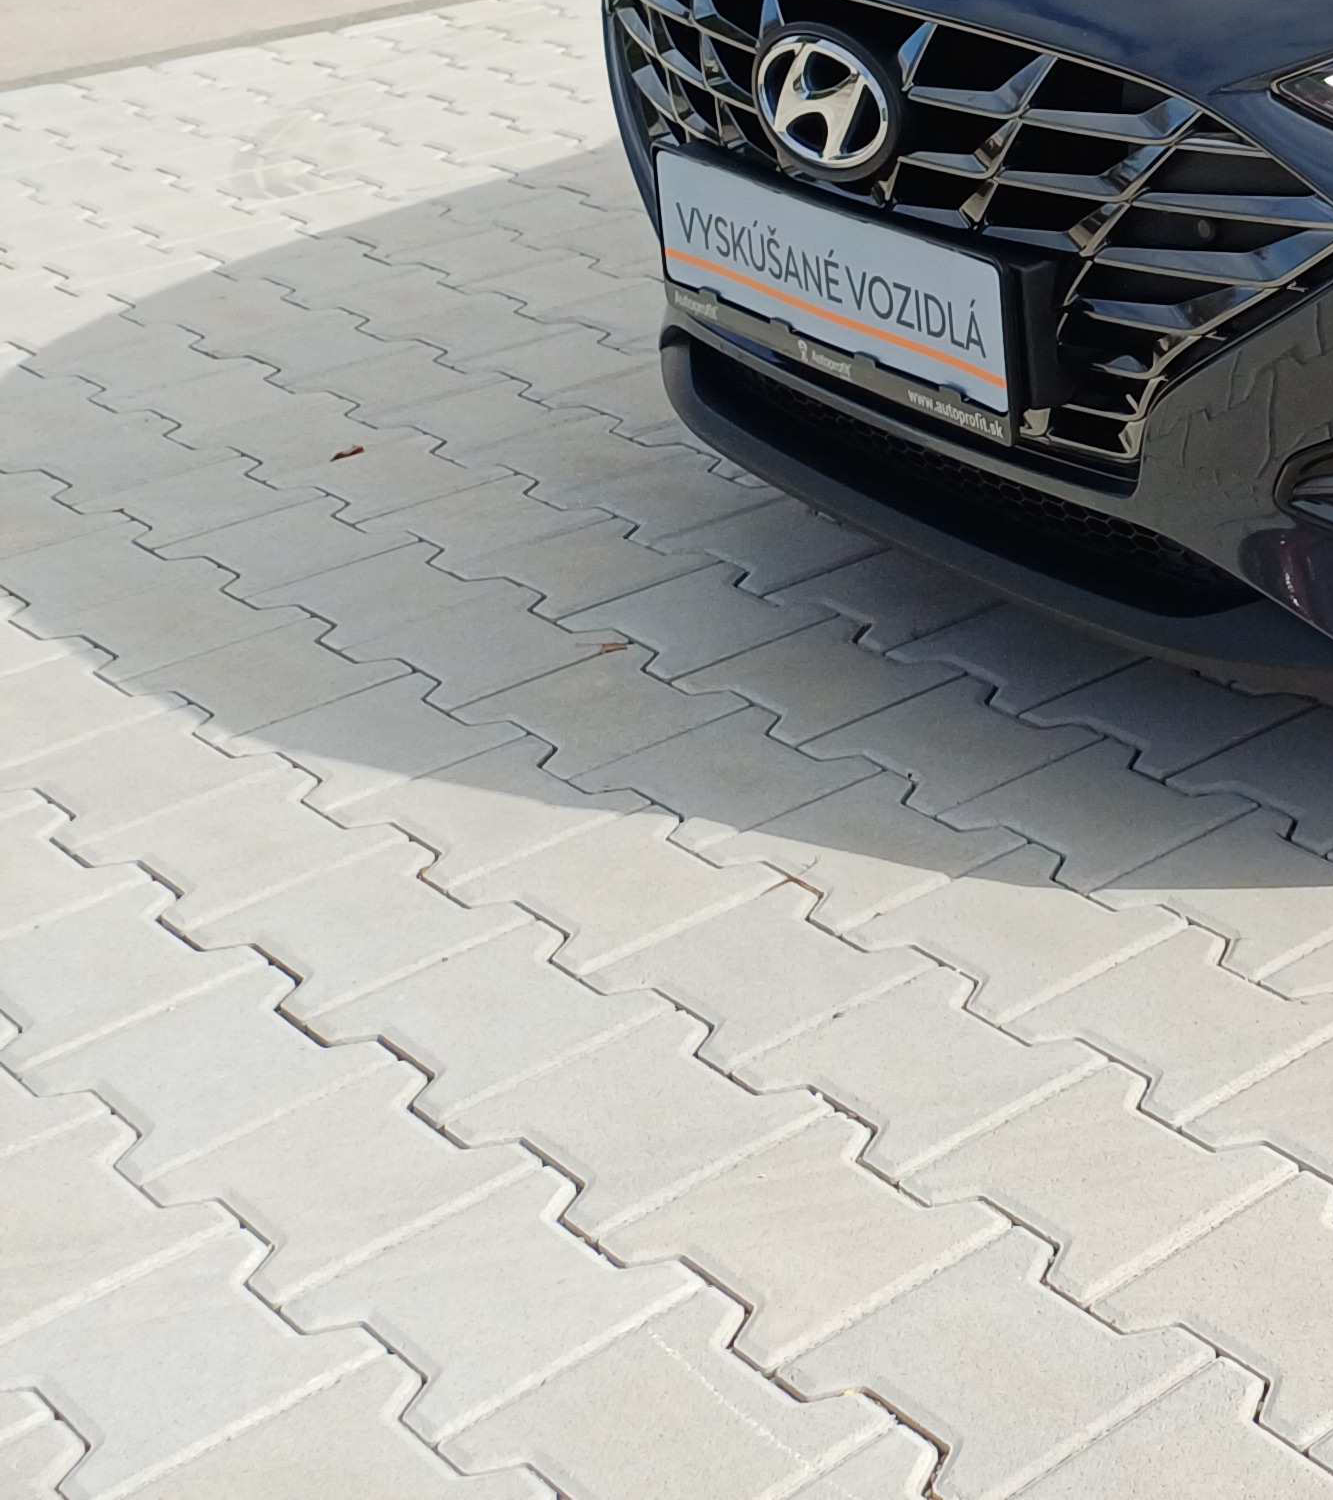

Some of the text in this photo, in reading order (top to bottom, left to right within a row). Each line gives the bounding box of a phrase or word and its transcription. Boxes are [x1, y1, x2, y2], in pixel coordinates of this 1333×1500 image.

[676, 201, 988, 359] VYSKÚŠANÉ VOZIDLÁ
[907, 388, 1005, 439] www.autoprofit.sk
